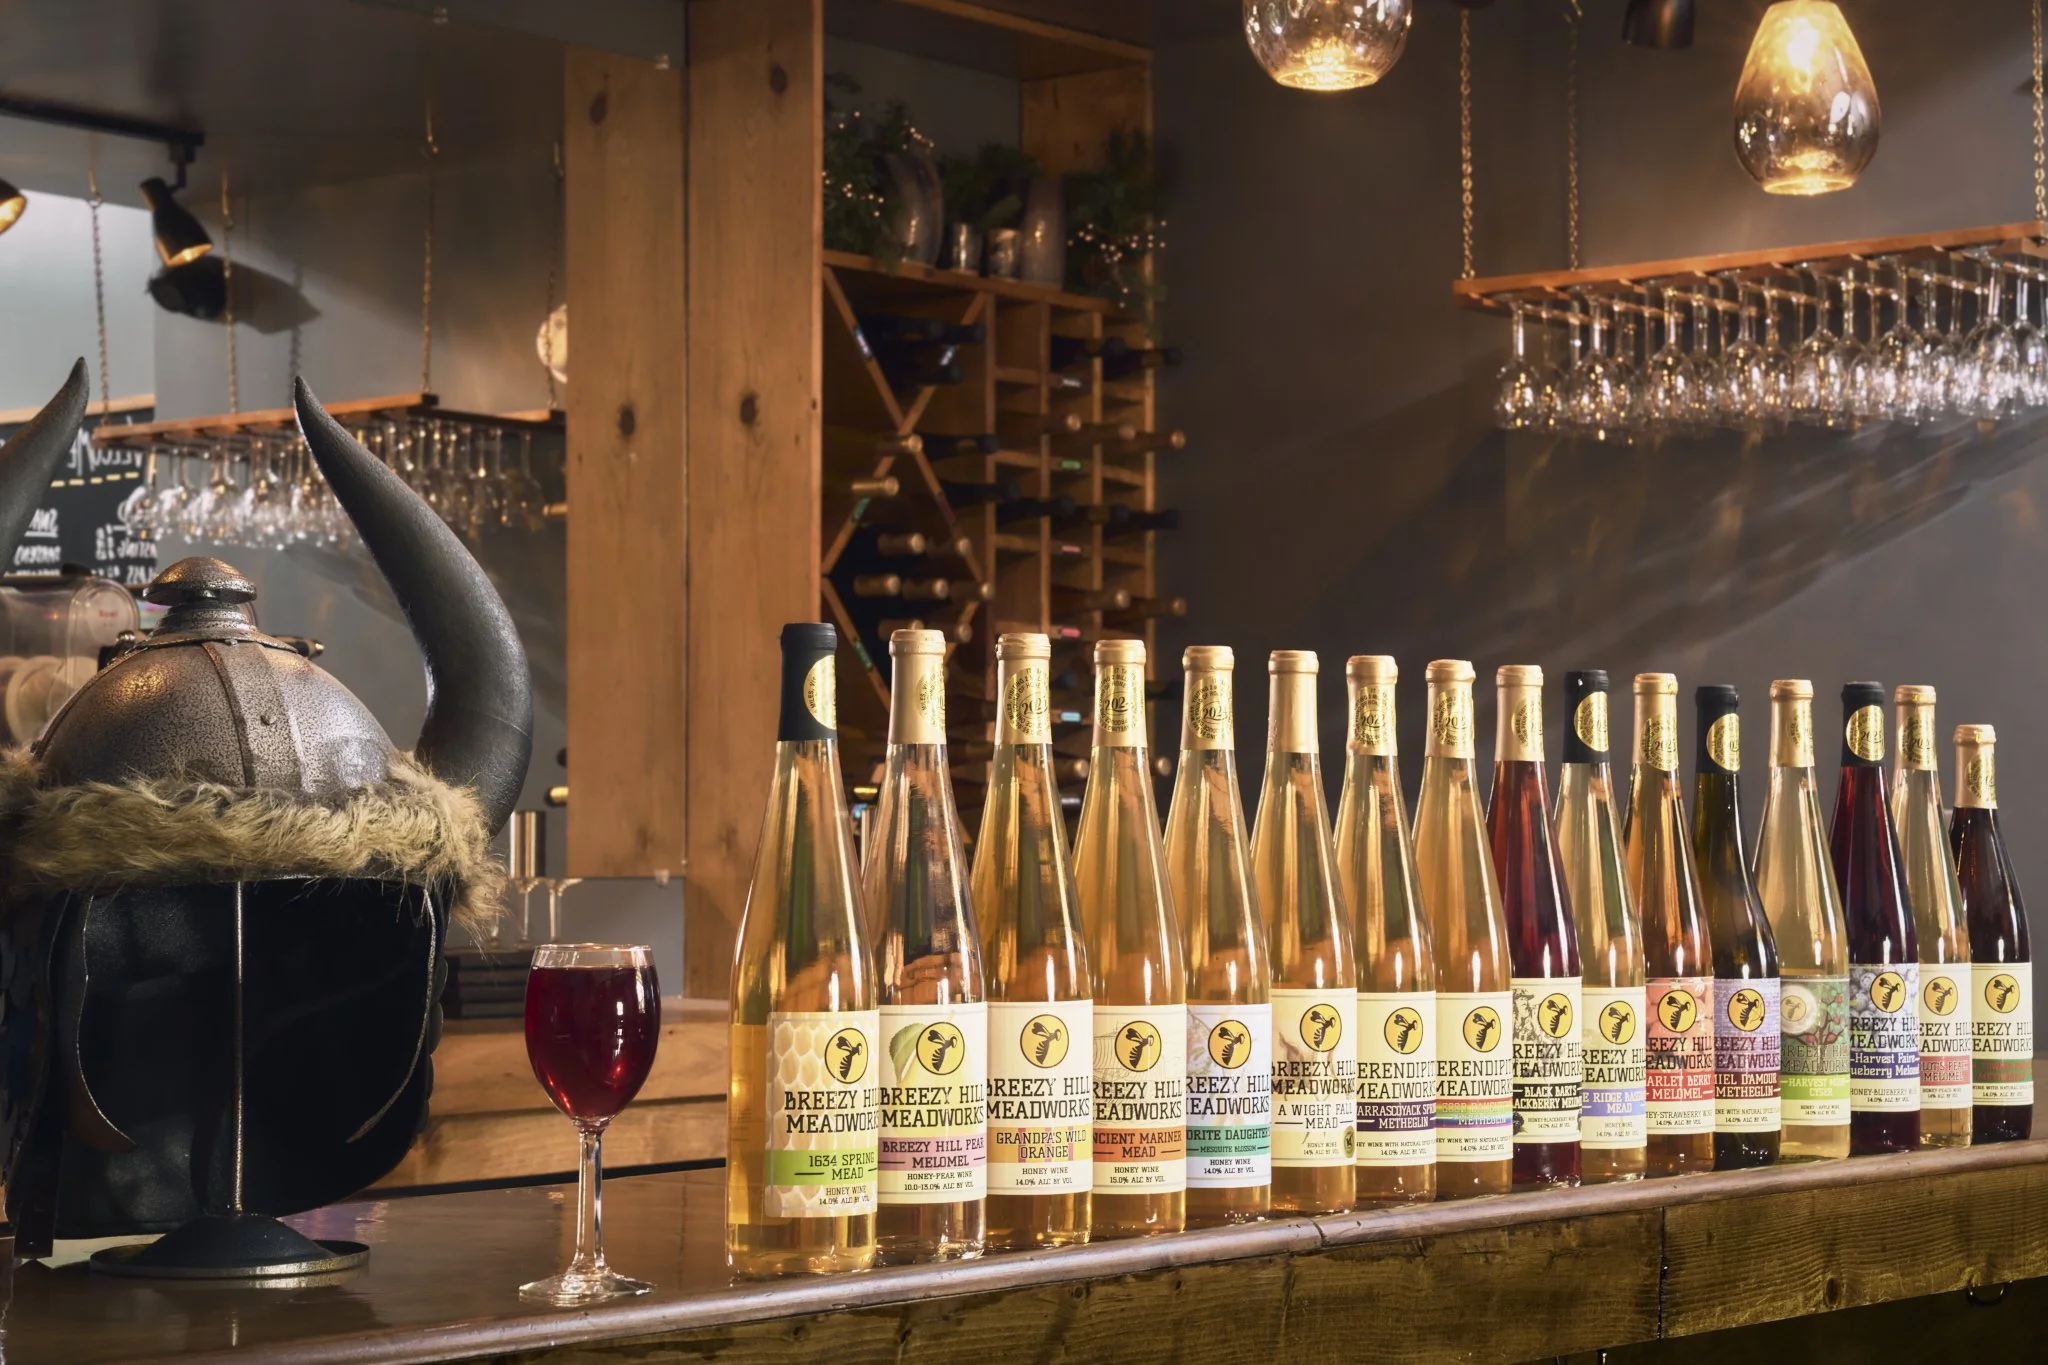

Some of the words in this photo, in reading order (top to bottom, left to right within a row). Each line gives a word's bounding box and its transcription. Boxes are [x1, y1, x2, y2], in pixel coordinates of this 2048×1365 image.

[1851, 1017, 1896, 1031] REEZY
[1920, 1023, 1950, 1036] EEZY
[1972, 1023, 2011, 1035] EEZY
[1649, 1038, 1687, 1051] EEZY
[1693, 1036, 1712, 1051] HILL
[1715, 1037, 1756, 1051] REEZY
[1920, 1038, 1971, 1052] ADWORK
[1513, 1044, 1561, 1058] REEZY
[1582, 1050, 1627, 1064] REEZY
[1647, 1054, 1712, 1069] EADWORKS
[1715, 1054, 1779, 1068] EADWORKS
[1855, 1053, 1894, 1063] Harvest
[1358, 1061, 1434, 1079] ERENDIPIT
[1437, 1059, 1511, 1077] ERENDIPIT
[1582, 1067, 1645, 1082] EADWORK
[1851, 1065, 1892, 1078] ueberry
[1186, 1077, 1240, 1093] REEZY
[1247, 1075, 1269, 1092] HILL
[1647, 1076, 1683, 1086] ARLET
[1688, 1074, 1711, 1086] BERRY
[1741, 1073, 1777, 1084] D'AMOUR
[1789, 1078, 1828, 1087] HARVEST
[1064, 1076, 1090, 1095] HILL
[1093, 1082, 1147, 1099] REEZY
[1155, 1080, 1182, 1098] HILL
[1524, 1087, 1552, 1097] BLACK
[1716, 1086, 1773, 1097] METHEGLIN
[785, 1090, 857, 1110] BREEZY
[880, 1087, 952, 1105] BREEZY
[960, 1084, 984, 1103] HILL
[1593, 1092, 1622, 1103] RIDGE
[1652, 1088, 1702, 1099] MELOMEL
[987, 1098, 1089, 1119] MEADWORKS
[1186, 1096, 1269, 1114] EADWORKS
[1278, 1104, 1287, 1115] A
[1292, 1104, 1331, 1115] WIGHT
[1336, 1103, 1352, 1115] FALL
[1514, 1098, 1560, 1108] ACKBERRY
[1607, 1103, 1632, 1113] MEAD
[882, 1106, 983, 1127] MEADWORKS
[1093, 1101, 1181, 1120] EADWORKS
[1358, 1104, 1421, 1116] ARRASCOYACK
[1306, 1117, 1338, 1129] MEAD
[1379, 1116, 1428, 1128] METHEGLIN
[997, 1132, 1061, 1144] GRANDPA'S
[1066, 1130, 1086, 1142] WILD
[1093, 1133, 1135, 1144] NCIENT
[1140, 1131, 1181, 1144] MARINER
[1187, 1130, 1220, 1140] ORITE
[883, 1141, 931, 1152] BREEZY
[936, 1140, 962, 1152] HILL
[966, 1137, 984, 1150] PEAR
[1021, 1146, 1068, 1158] ORANGE
[1122, 1146, 1155, 1158] MEAD
[809, 1155, 837, 1167] 1634
[842, 1152, 874, 1166] SPRING
[912, 1155, 969, 1168] MELOMEL
[832, 1167, 863, 1180] MEAD
[826, 1187, 850, 1196] HONEY
[852, 1185, 866, 1193] WINE
